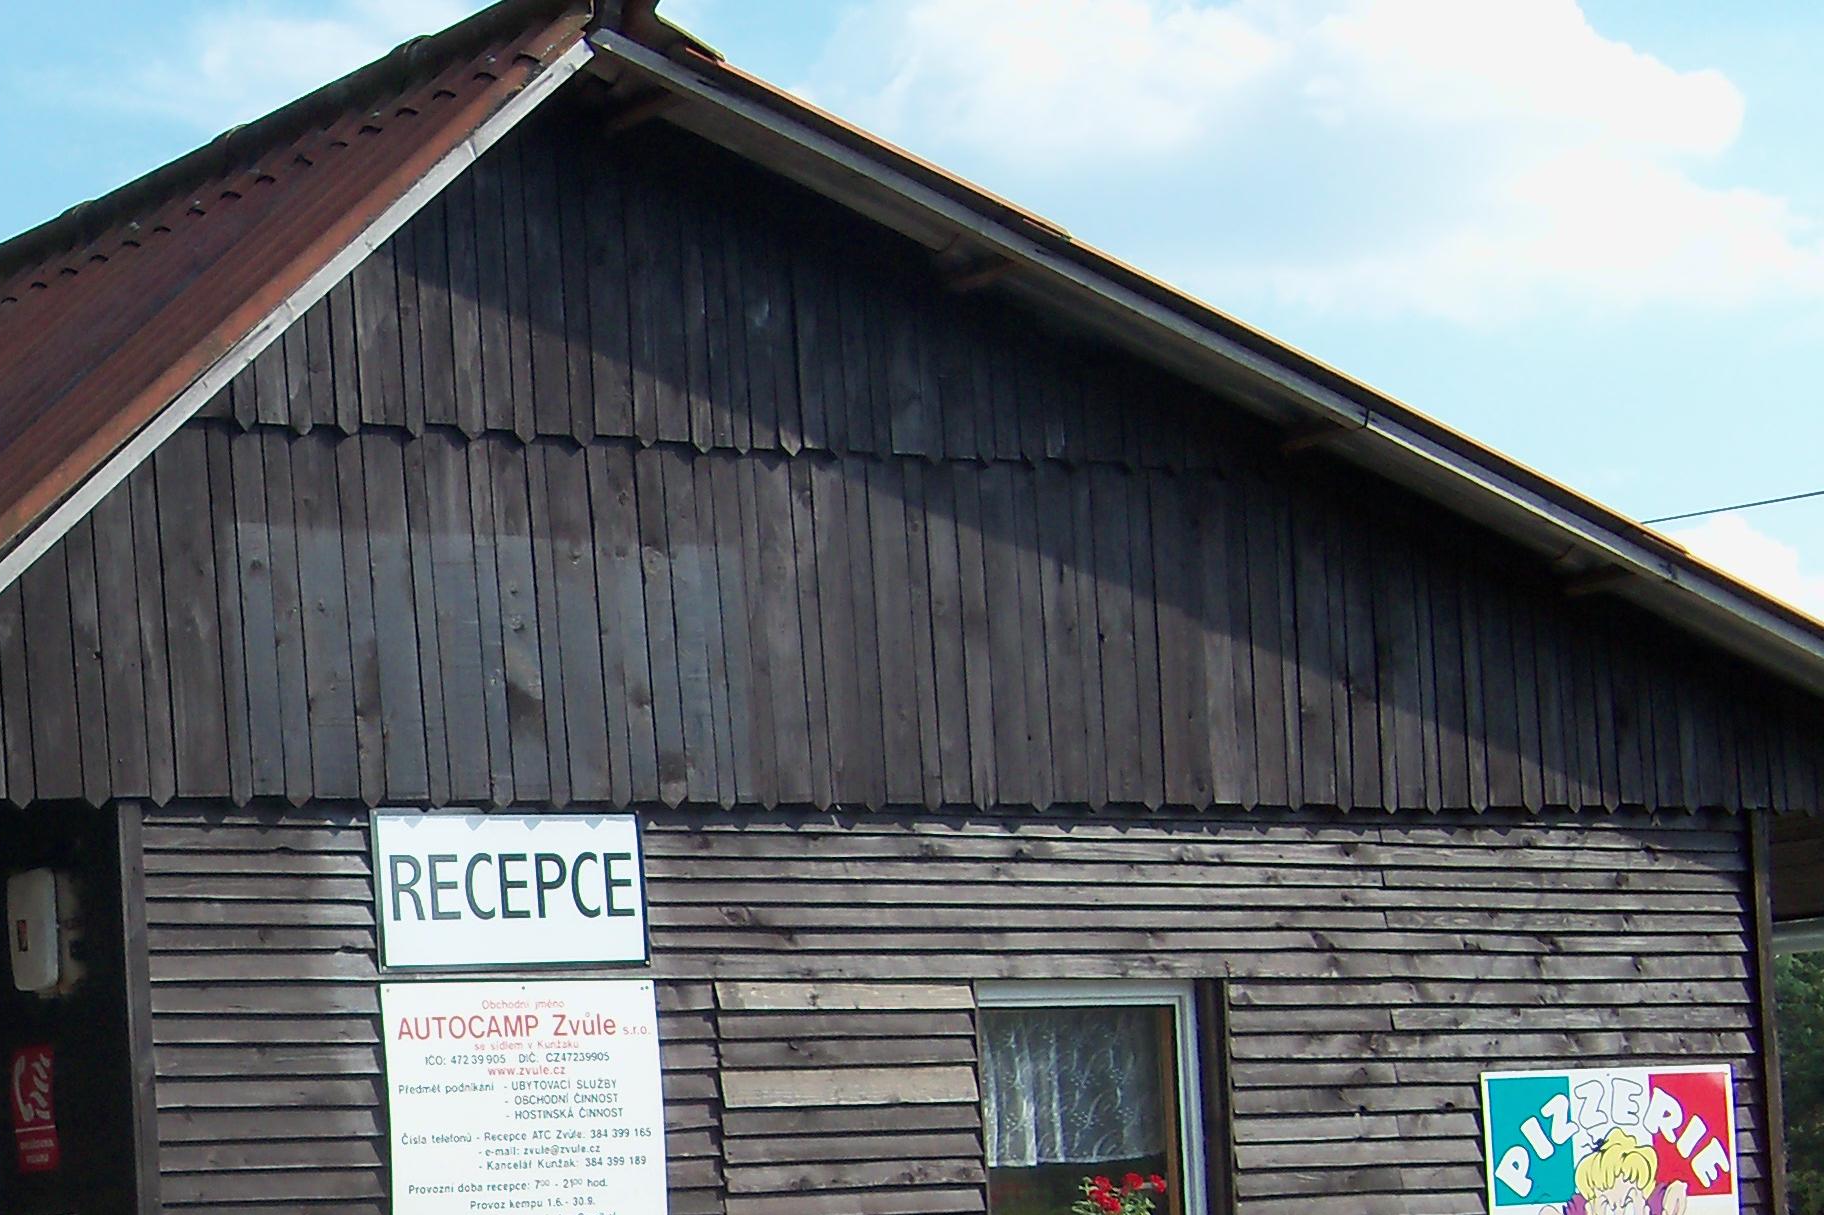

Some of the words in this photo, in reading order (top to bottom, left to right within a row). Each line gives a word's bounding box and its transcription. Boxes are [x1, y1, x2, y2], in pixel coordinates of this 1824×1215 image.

[389, 851, 635, 921] RECEPCE
[398, 1014, 539, 1040] AUTOCAMP
[552, 1011, 616, 1036] Zvůle
[622, 1025, 651, 1035] s.r.o.
[545, 1051, 610, 1063] CZ47239905
[487, 1065, 566, 1076] www.zvule.cz
[576, 1077, 617, 1090] SLUŽBY
[574, 1092, 619, 1104] ČINNOST
[514, 1107, 574, 1120] HOSTINSKÁ
[578, 1106, 624, 1119] ČINNOST
[484, 1131, 527, 1142] Recepce
[532, 1129, 551, 1140] ATC
[590, 1128, 608, 1139] 384
[611, 1127, 630, 1138] 399
[634, 1127, 652, 1137] 165
[1495, 1078, 1731, 1198] PIZZERIE
[523, 1144, 601, 1156] zvule@zvule.cz
[585, 1156, 603, 1167] 384
[607, 1156, 625, 1167] 399
[629, 1155, 647, 1165] 189
[457, 1182, 483, 1193] doba
[486, 1182, 530, 1193] recepce:
[587, 1178, 608, 1188] hod.
[470, 1200, 505, 1210] Provoz
[509, 1199, 542, 1210] kempu
